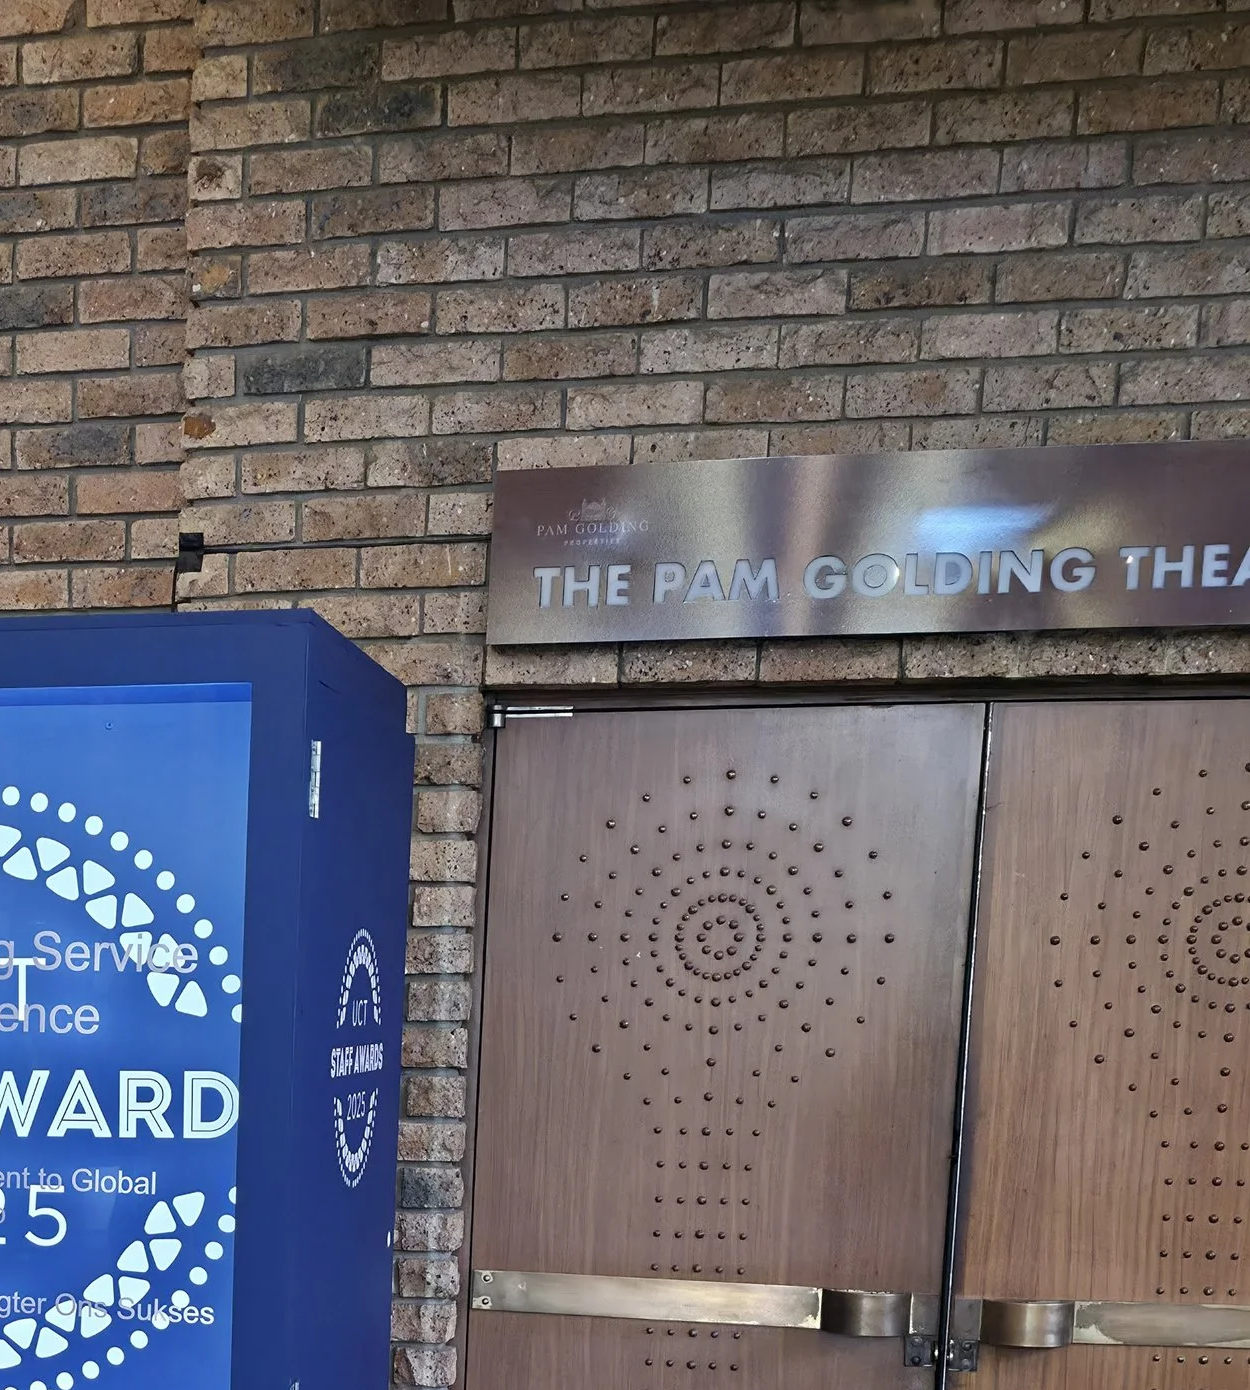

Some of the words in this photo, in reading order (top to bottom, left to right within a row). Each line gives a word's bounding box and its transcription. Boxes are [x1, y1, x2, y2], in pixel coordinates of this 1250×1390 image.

[537, 523, 568, 536] PAM
[575, 519, 649, 535] GOLDING
[533, 564, 631, 608] THE
[654, 557, 780, 604] PAM
[803, 547, 1097, 601] GOLDING
[33, 930, 198, 974] Service
[352, 999, 368, 1027] UCT
[331, 1047, 353, 1078] STAFF
[354, 1043, 383, 1073] AWARDS
[347, 1091, 366, 1121] 2025
[38, 1167, 63, 1191] to
[72, 1168, 156, 1195] Global
[55, 1293, 107, 1318] Ons
[117, 1297, 214, 1325] Sukses
